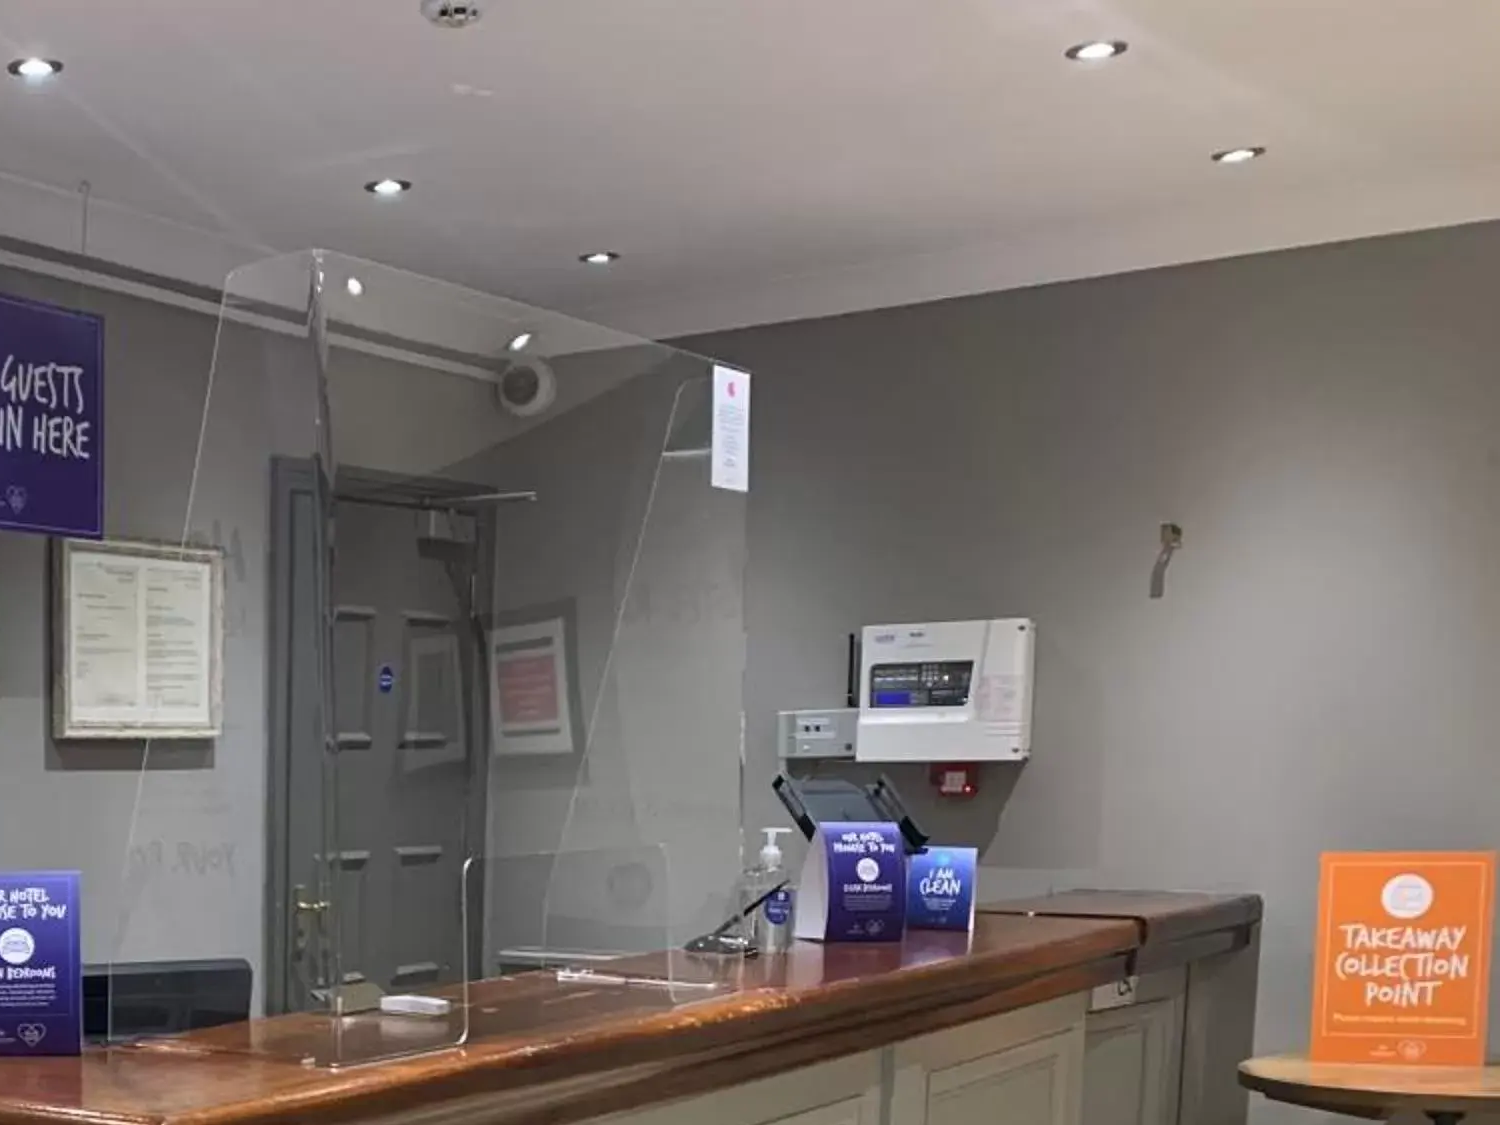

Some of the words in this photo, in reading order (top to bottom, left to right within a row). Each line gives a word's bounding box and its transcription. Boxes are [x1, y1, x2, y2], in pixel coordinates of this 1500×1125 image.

[0, 354, 83, 414] GUESTS
[33, 414, 90, 459] HERE
[937, 867, 953, 879] AM
[10, 888, 49, 903] HOTEL
[919, 879, 961, 895] CLEAN
[20, 903, 37, 919] TO
[41, 903, 67, 920] YOU
[1339, 923, 1466, 951] TAKEAWAY
[1335, 952, 1469, 981] COLLECTION
[1364, 981, 1443, 1007] POINT
